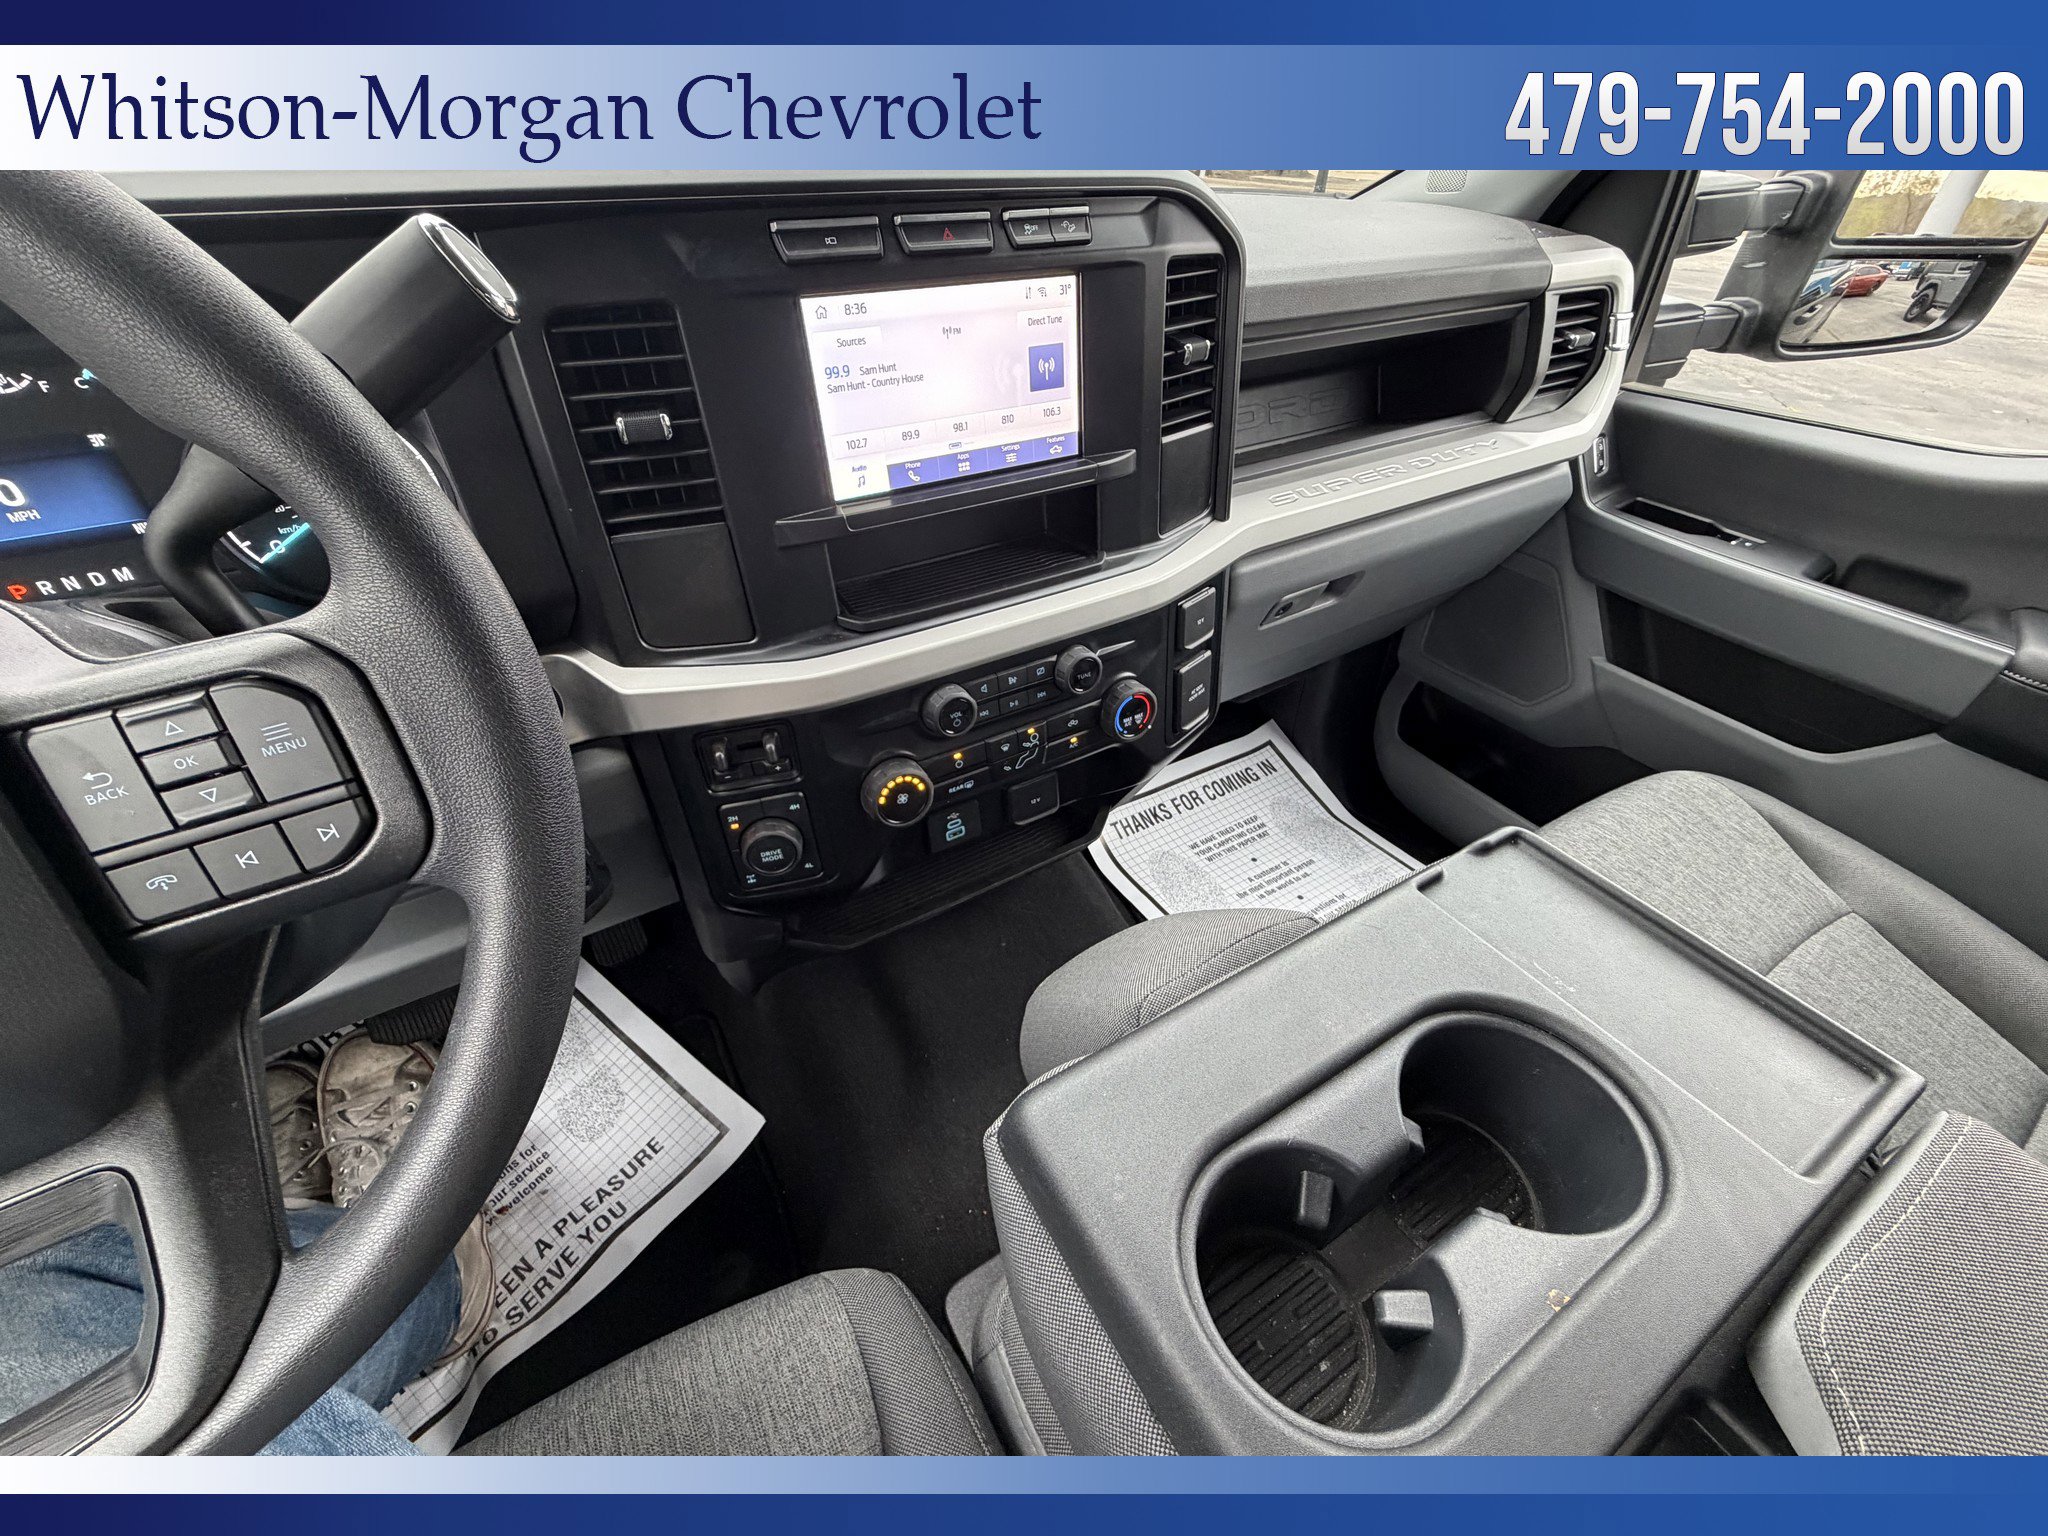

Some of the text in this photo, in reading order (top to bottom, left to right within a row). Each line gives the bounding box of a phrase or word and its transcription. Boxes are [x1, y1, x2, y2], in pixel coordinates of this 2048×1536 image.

[1059, 283, 1072, 295] 31°
[844, 302, 868, 316] 8:36
[1028, 314, 1063, 327] Direct Tune
[953, 327, 962, 335] FM
[836, 336, 867, 348] Sources
[824, 362, 897, 379] 99.9 Sam Hunt
[37, 376, 90, 393] F C
[827, 384, 846, 394] Sam
[846, 380, 866, 392] Hunt
[871, 376, 900, 390] Country
[901, 373, 924, 384] House
[1236, 386, 1346, 432] ORD
[846, 406, 1062, 451] 102.7 89.9 98.1 810 106.3
[1001, 444, 1021, 452] Settings
[1046, 436, 1066, 444] Features
[905, 461, 921, 470] Phone
[957, 453, 969, 461] Apps
[851, 464, 868, 473] Audio
[1267, 437, 1501, 506] SUPER DUTY
[6, 509, 42, 524] MPH
[7, 566, 135, 600] P R N D M
[1077, 671, 1092, 681] TUNE
[950, 711, 963, 719] VOL
[260, 736, 308, 758] MENU
[173, 754, 199, 771] OK
[84, 785, 130, 806] BACK
[949, 784, 964, 793] REAR
[1110, 758, 1278, 840] THANKS FOR COMING IN
[1189, 815, 1258, 850] WE HAVE TRIED TO KEEP
[1195, 822, 1267, 857] YOUR CARPETING CLEAN
[760, 849, 783, 858] DRIVE
[1205, 830, 1270, 862] WITH THIS PAPER MAT
[762, 854, 784, 863] MODE
[1236, 859, 1316, 899] the most important person
[1254, 864, 1282, 880] customer
[1276, 879, 1295, 890] world
[499, 1143, 537, 1180] ons for
[508, 1151, 550, 1189] service
[493, 1136, 665, 1309] EEN A PLEASURE
[466, 1199, 629, 1359] TO SERVE YOU
